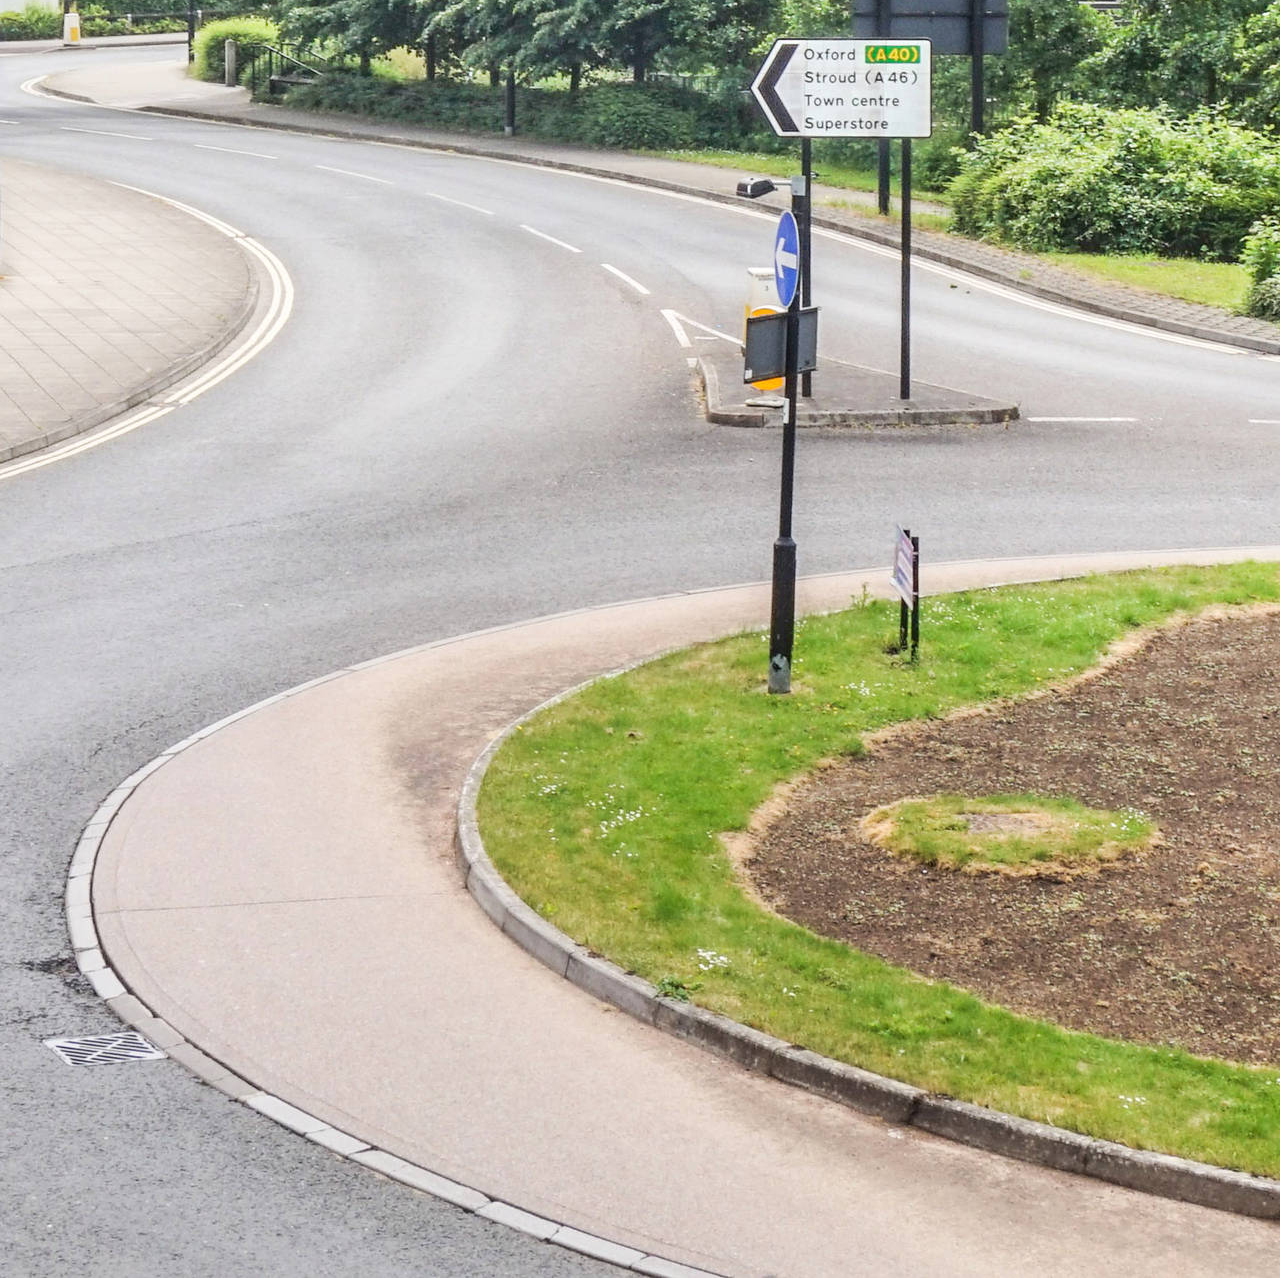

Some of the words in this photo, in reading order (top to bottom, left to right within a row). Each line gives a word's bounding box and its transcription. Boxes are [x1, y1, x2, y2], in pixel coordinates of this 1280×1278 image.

[804, 48, 856, 60] Oxford
[867, 47, 919, 62] (A40)
[804, 71, 856, 84] Stroud
[804, 95, 844, 107] Town
[851, 96, 900, 107] centre
[804, 117, 889, 132] Superstore
